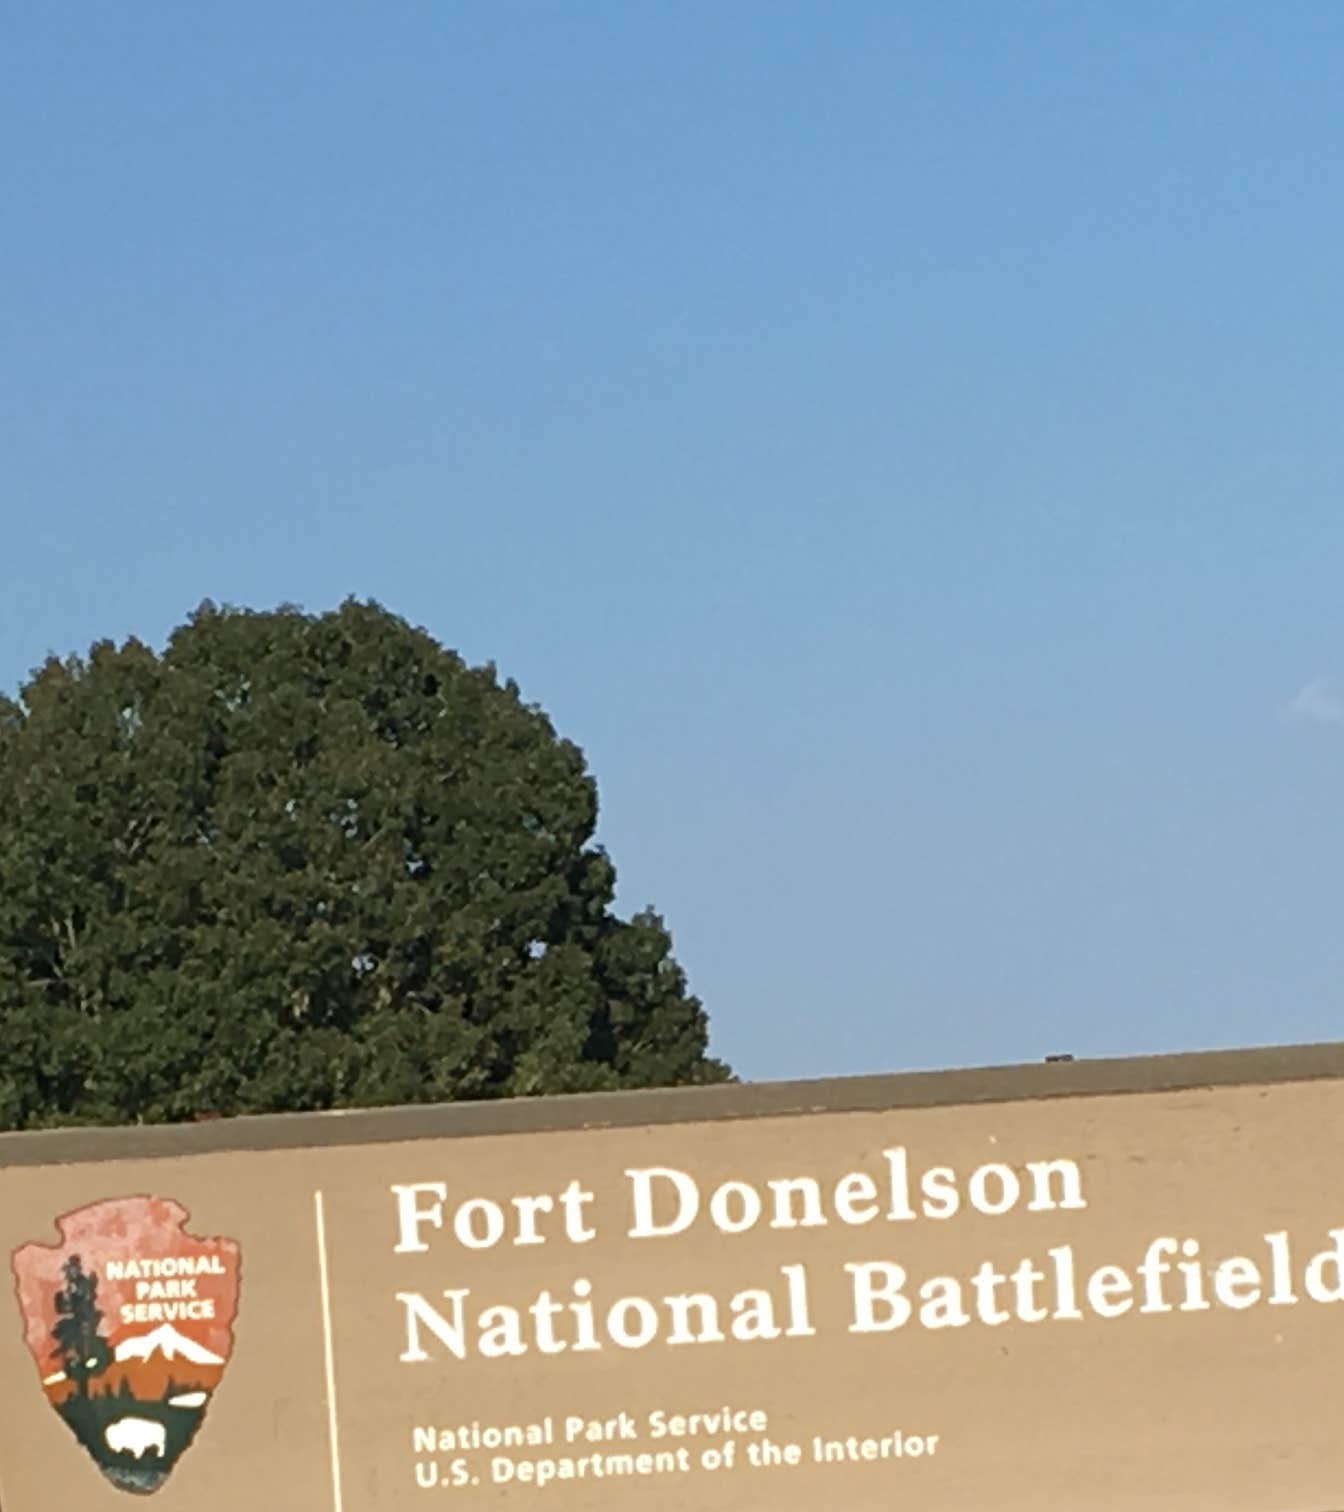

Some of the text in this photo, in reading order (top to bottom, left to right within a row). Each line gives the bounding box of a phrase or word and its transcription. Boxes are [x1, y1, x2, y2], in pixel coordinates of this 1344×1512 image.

[390, 1146, 1087, 1253] Fort Donelson
[105, 1254, 227, 1281] NATIONAL
[135, 1278, 198, 1301] PARK
[119, 1299, 216, 1325] SERVICE
[395, 1263, 816, 1363] National
[412, 1406, 768, 1453] National Park Service
[415, 1430, 940, 1488] U.S. Department of the Interior
